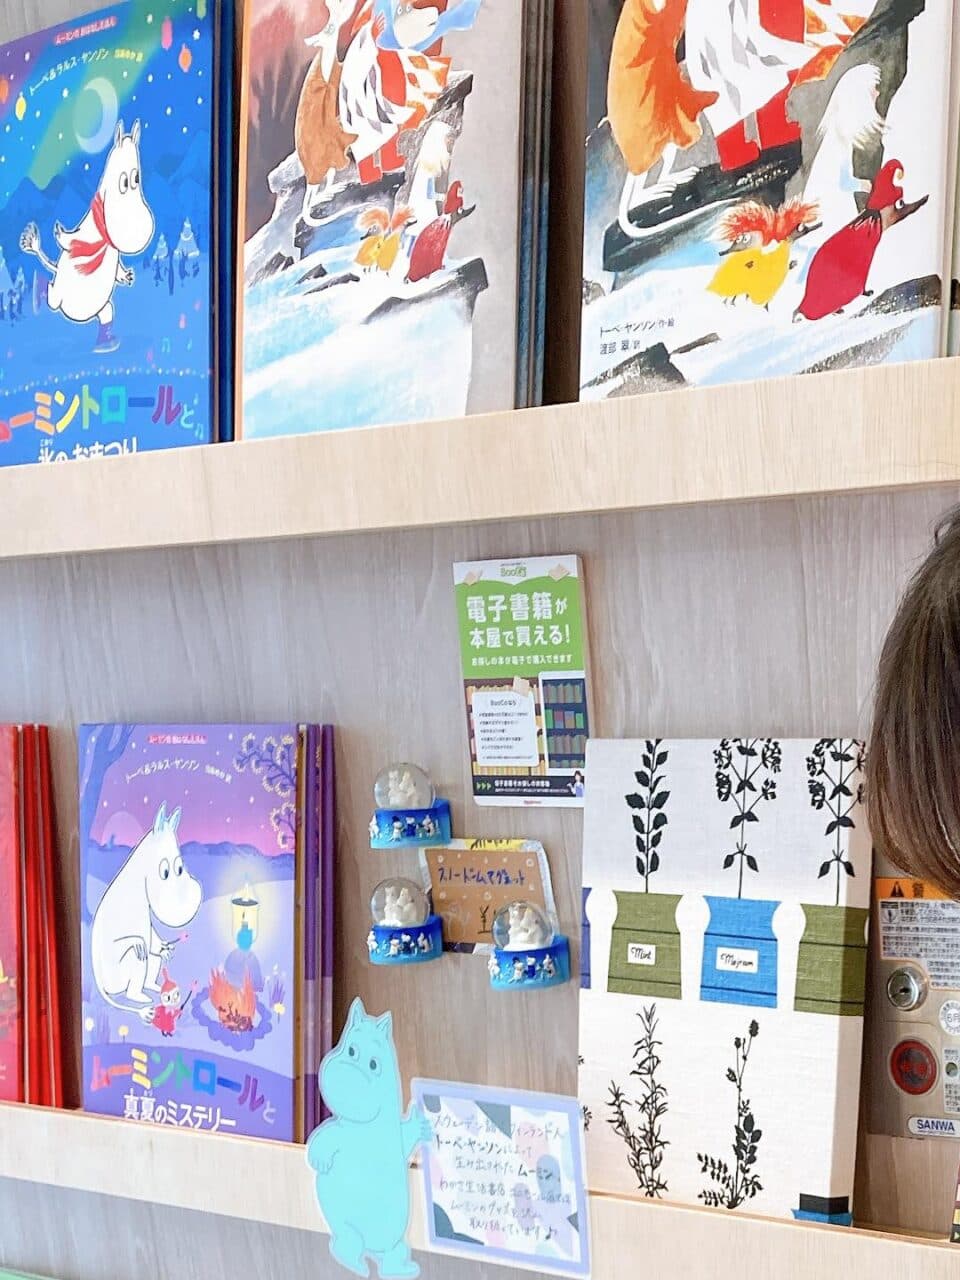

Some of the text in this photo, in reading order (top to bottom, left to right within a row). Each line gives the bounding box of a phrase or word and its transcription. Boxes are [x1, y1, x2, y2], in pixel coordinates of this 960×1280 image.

[0, 384, 195, 443] ーミントロールと
[466, 592, 568, 623] 電子書籍が
[469, 624, 570, 649] 本屋で買える!
[91, 1047, 277, 1125] ムーミントロールと
[123, 1090, 237, 1132] 真夏のミステリー
[916, 1118, 956, 1133] SANWA
